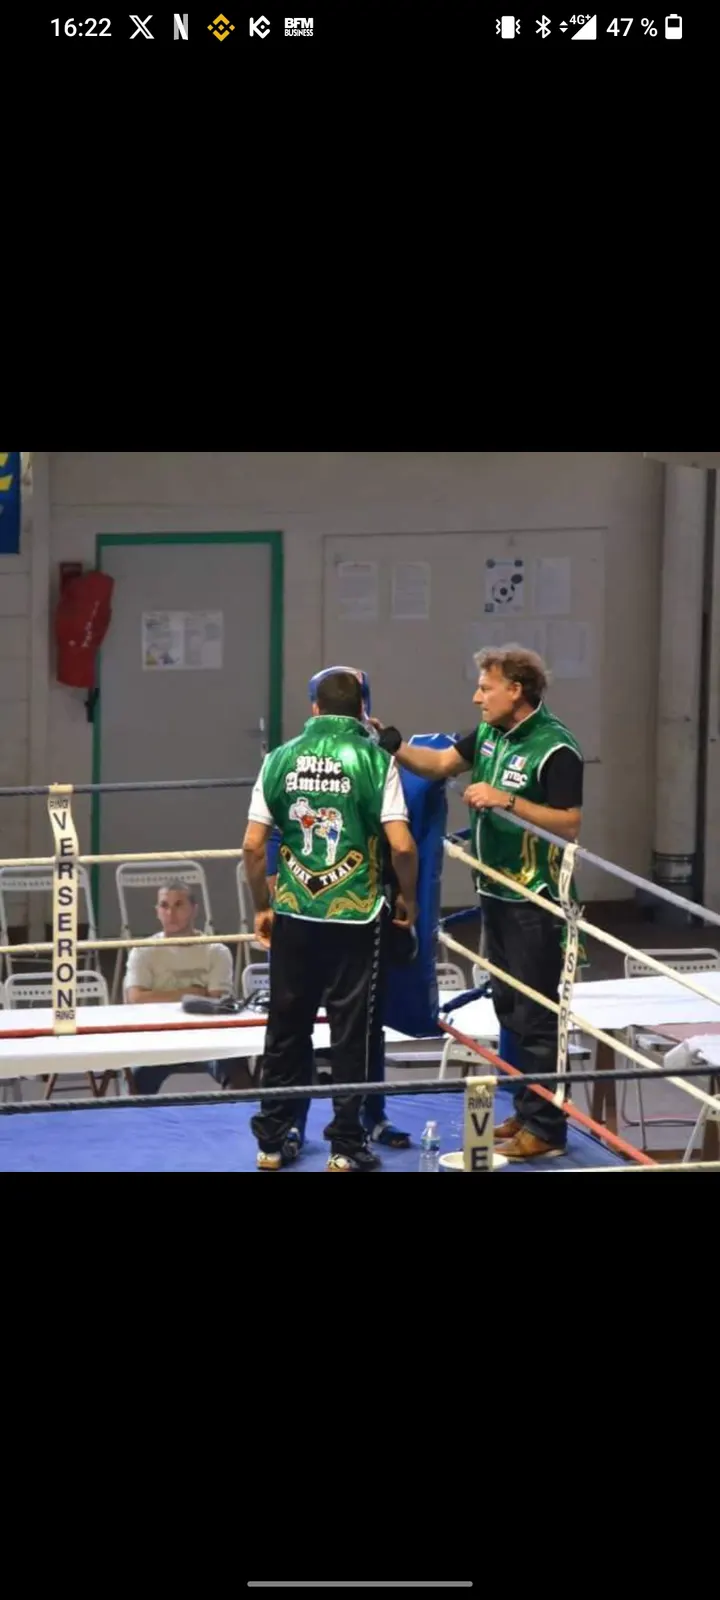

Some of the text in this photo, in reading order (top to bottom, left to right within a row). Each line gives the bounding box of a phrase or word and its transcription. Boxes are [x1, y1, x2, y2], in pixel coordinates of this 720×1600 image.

[285, 773, 350, 794] Amiens
[287, 859, 350, 886] MUAY THAI
[53, 812, 75, 1008] VERSERON
[55, 1010, 75, 1020] RING
